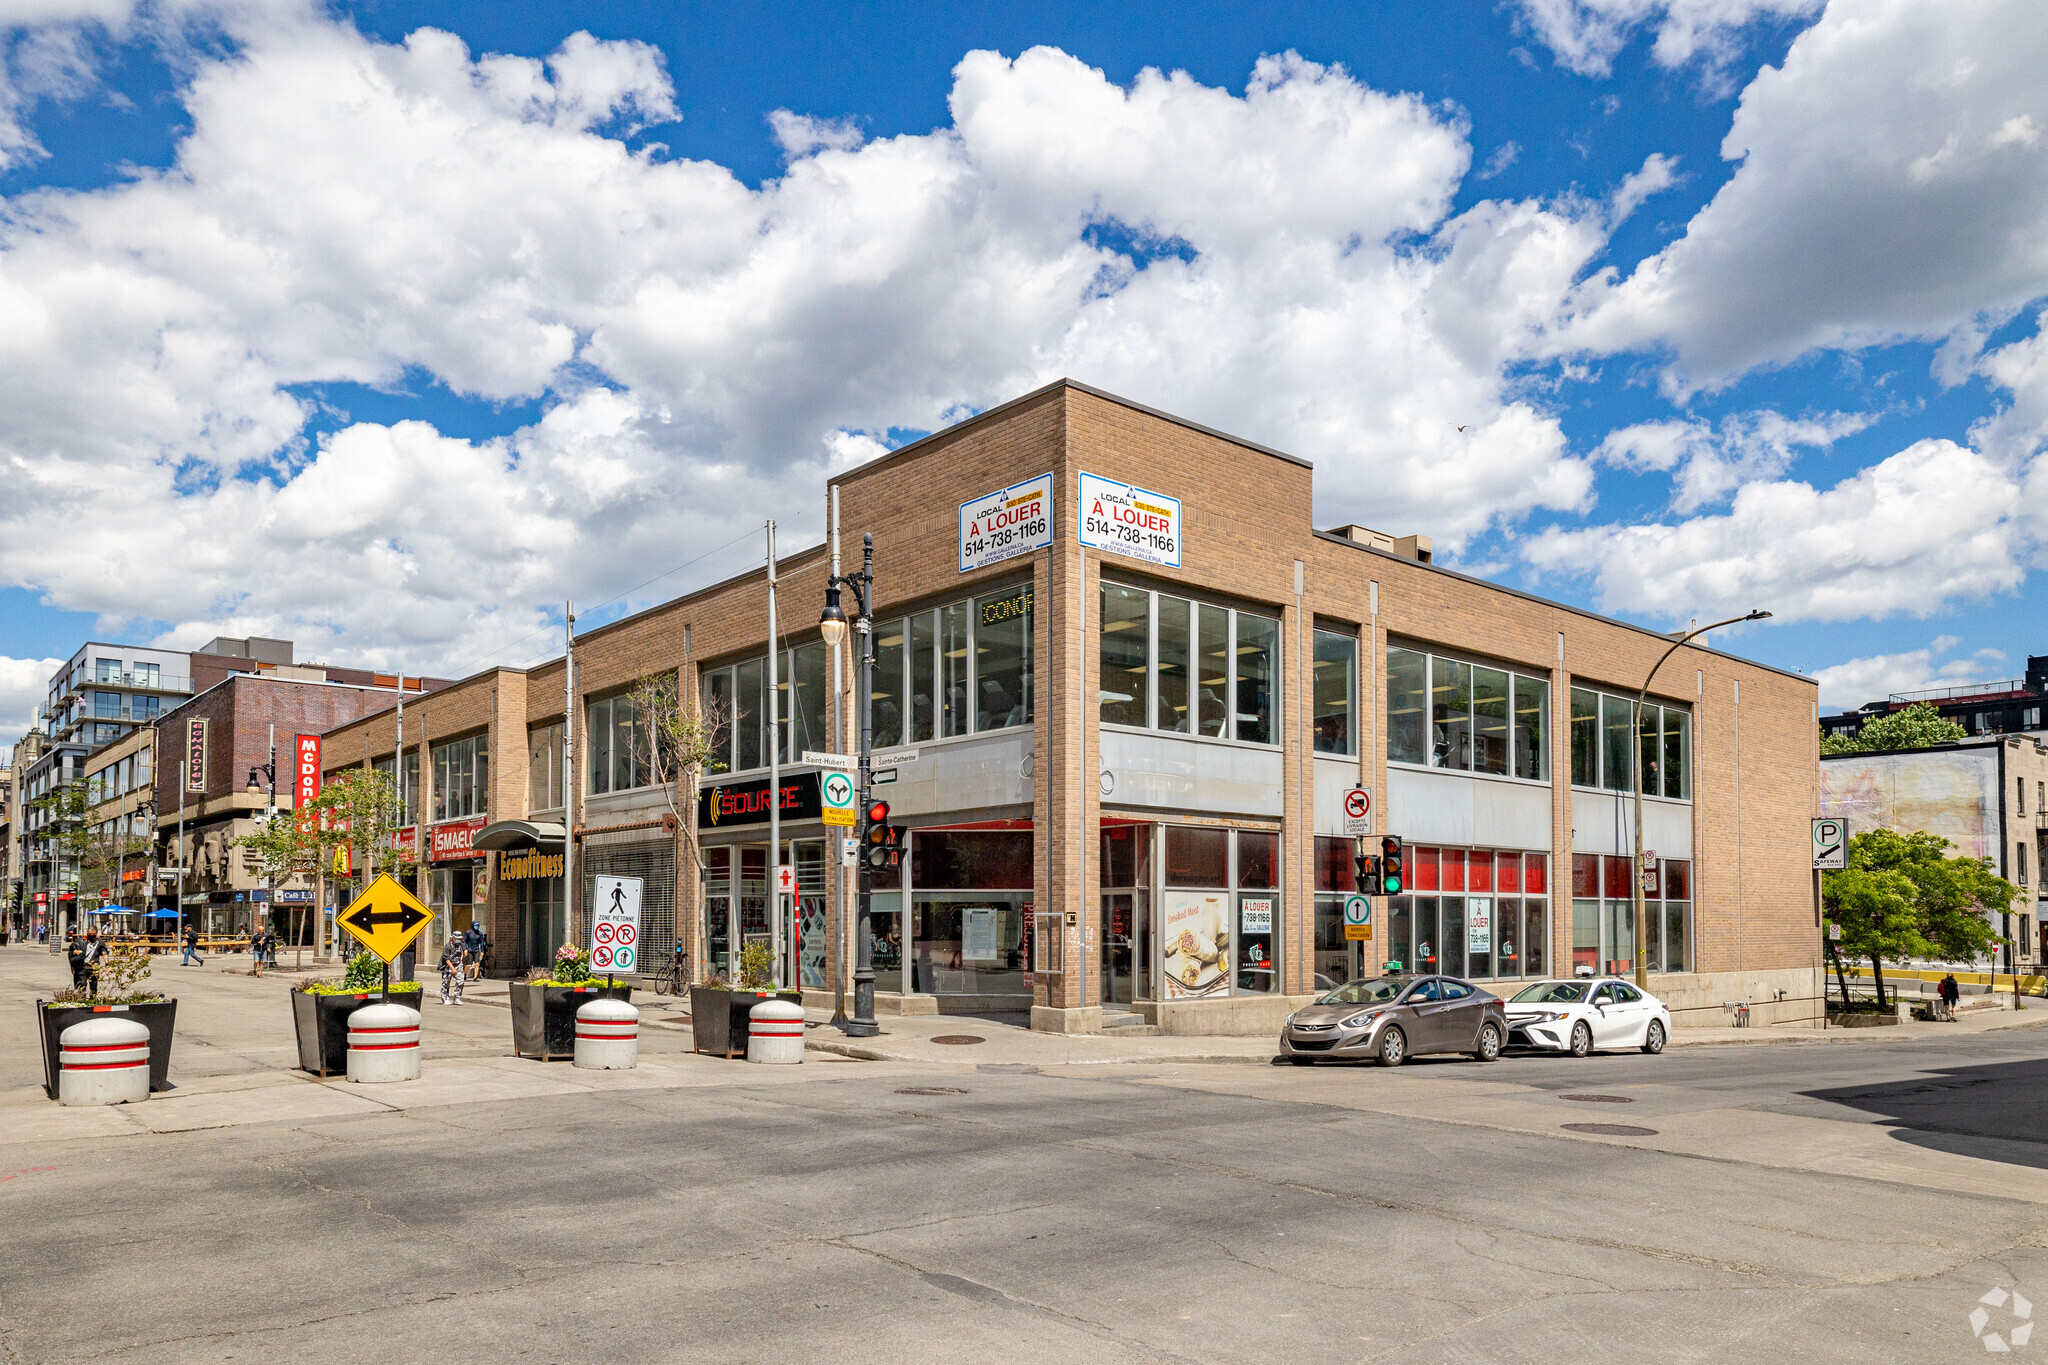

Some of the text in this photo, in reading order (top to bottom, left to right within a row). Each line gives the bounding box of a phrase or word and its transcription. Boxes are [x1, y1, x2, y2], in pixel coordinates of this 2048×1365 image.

[1006, 501, 1017, 509] 830
[1100, 493, 1130, 506] LOCAL
[1134, 501, 1145, 509] 830
[977, 505, 1003, 519] LOCAL
[1092, 497, 1170, 534] À LOUER
[970, 502, 1041, 538] À LOUER
[965, 518, 1046, 557] 514-738-1166
[1086, 517, 1175, 553] 514-738-1166
[1006, 545, 1033, 558] GALLERIA
[1134, 551, 1162, 563] GALLERIA
[805, 756, 846, 767] Saint-Hubert
[723, 787, 731, 795] LA
[721, 786, 799, 815] SOURCE
[824, 815, 854, 823] SIGNALISATION
[501, 847, 563, 880] Econofitness
[1244, 900, 1270, 911] À LOUER
[1477, 905, 1482, 916] À
[1470, 917, 1489, 928] LOUER
